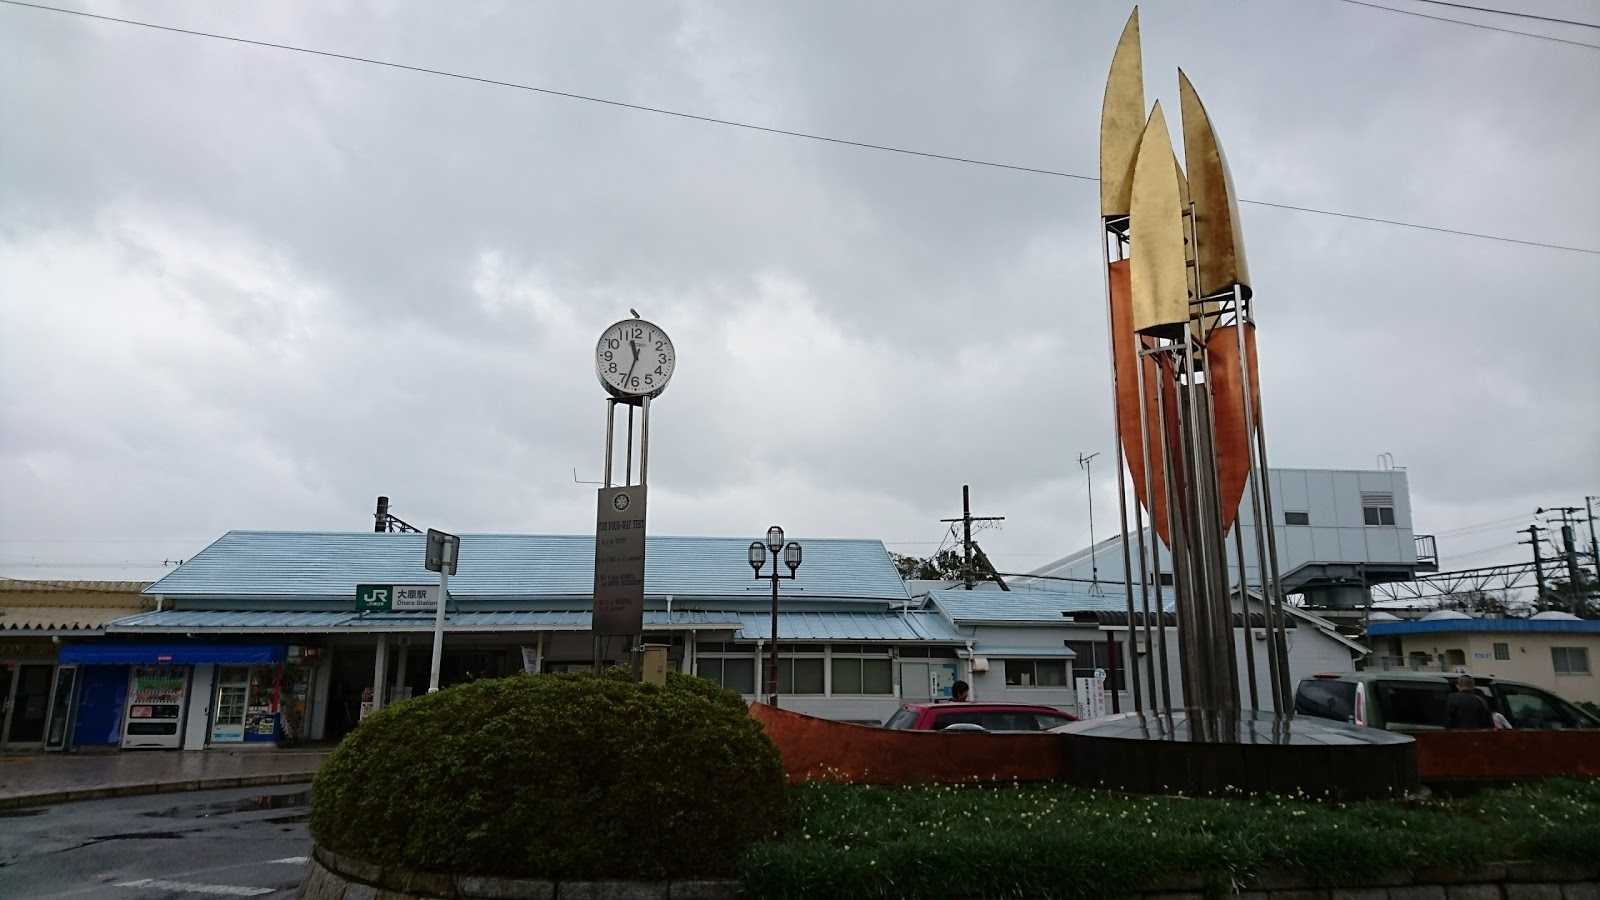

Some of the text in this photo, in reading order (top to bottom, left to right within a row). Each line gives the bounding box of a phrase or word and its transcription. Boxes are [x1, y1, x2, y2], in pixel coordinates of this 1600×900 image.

[619, 327, 629, 341] 11
[631, 328, 643, 339] 12
[605, 338, 620, 350] 10
[655, 341, 664, 351] 2
[604, 351, 613, 362] 9
[658, 353, 667, 364] 3
[608, 362, 617, 373] 8
[654, 365, 663, 376] 4
[619, 372, 627, 384] 7
[631, 376, 640, 387] 6
[644, 374, 653, 385] 5
[363, 589, 388, 602] JR
[397, 588, 427, 599] 大原駅
